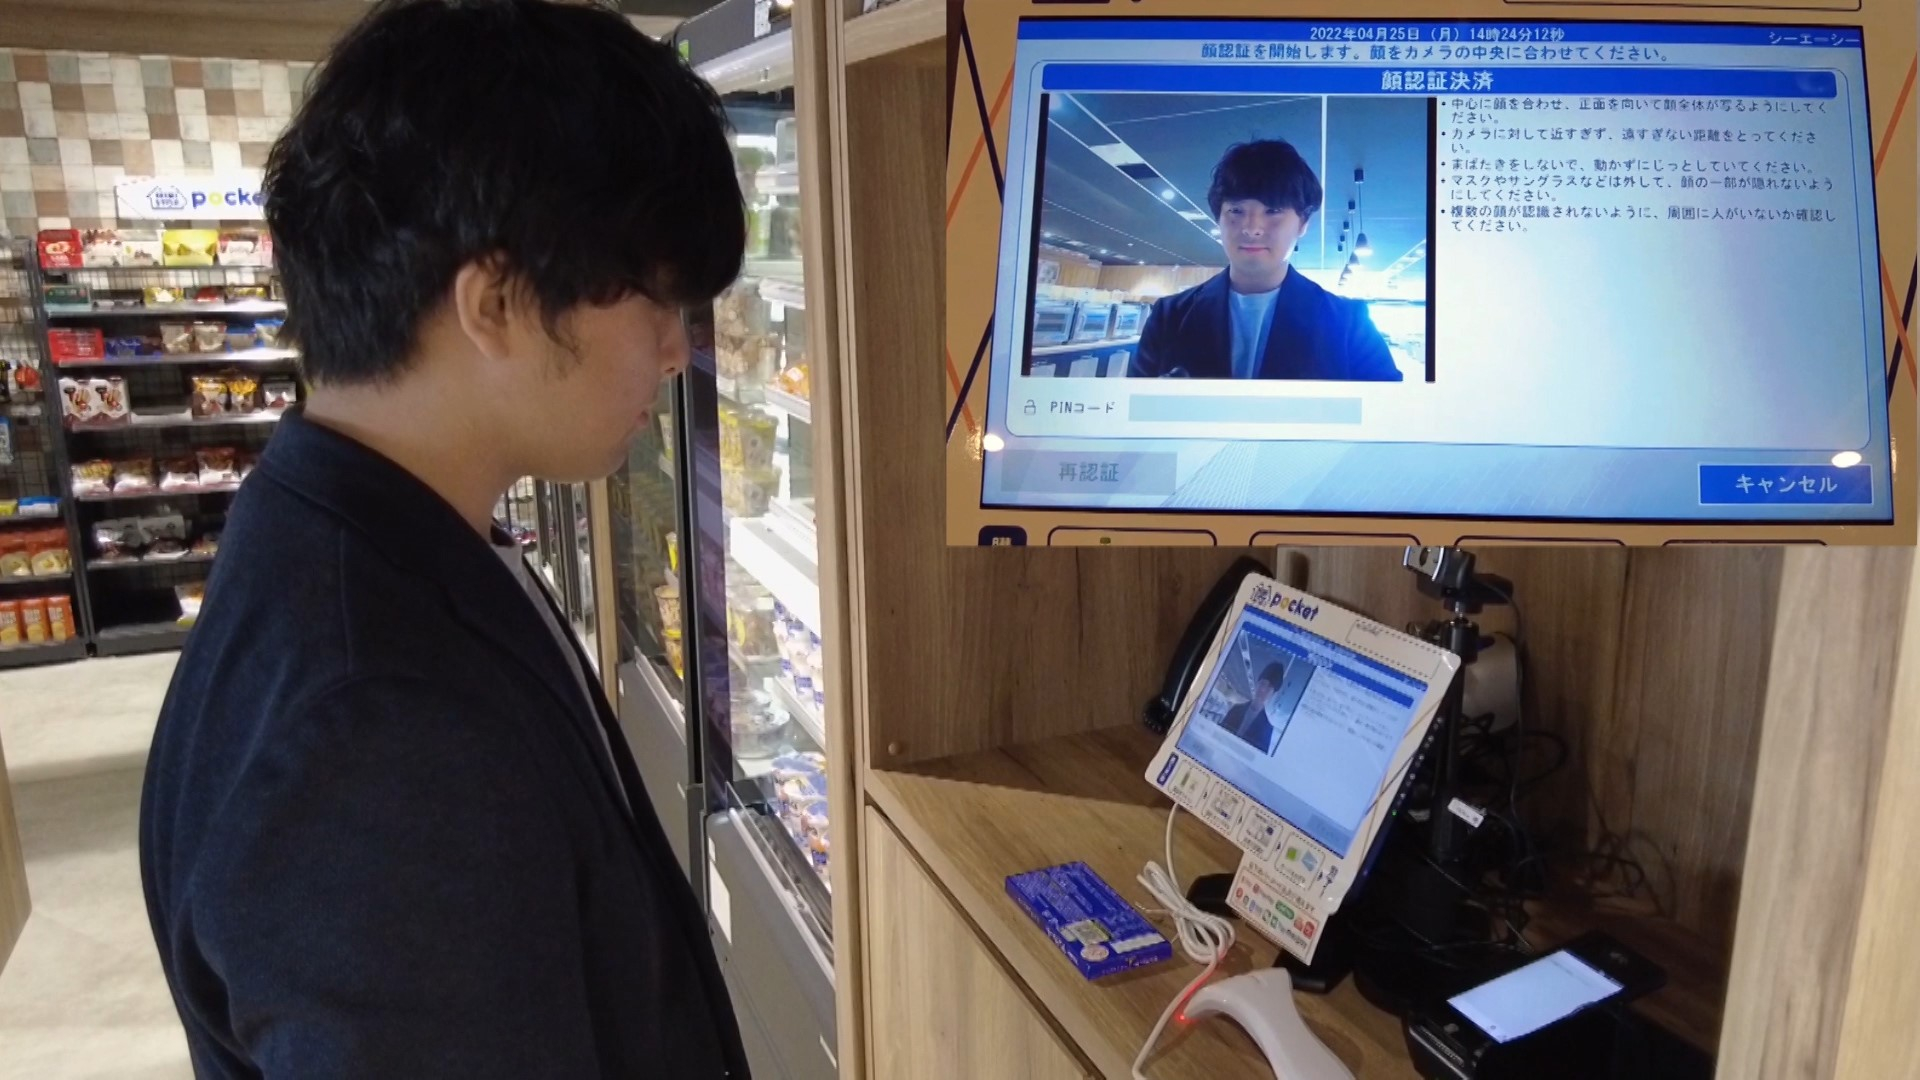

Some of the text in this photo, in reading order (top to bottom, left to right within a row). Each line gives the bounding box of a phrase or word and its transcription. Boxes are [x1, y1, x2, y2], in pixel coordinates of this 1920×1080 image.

[1768, 31, 1861, 46] シーエーシー
[1201, 43, 1668, 62] 顔認証を開始します。顔をカメラの中央に合わせてください。
[1381, 69, 1494, 91] 顔認証決済
[1451, 111, 1499, 124] ださい。
[1451, 127, 1817, 144] カメラに対して近すぎず、遠すぎない距離をとってくださ
[1451, 158, 1814, 174] まばたきをしないで、動かずにじっとしていてください。
[1451, 175, 1834, 191] マスクやサングラスなどは外して、顔の一部が隠れないよう
[1451, 189, 1557, 202] にしてください。
[1451, 205, 1836, 222] 複数の顔が認識されないように、周囲に人がいないか確認し
[1451, 219, 1529, 232] てください。
[1050, 401, 1116, 414] PINコード
[1059, 462, 1120, 482] 再認証
[1735, 474, 1838, 494] キャンセル
[1270, 592, 1319, 621] pocket
